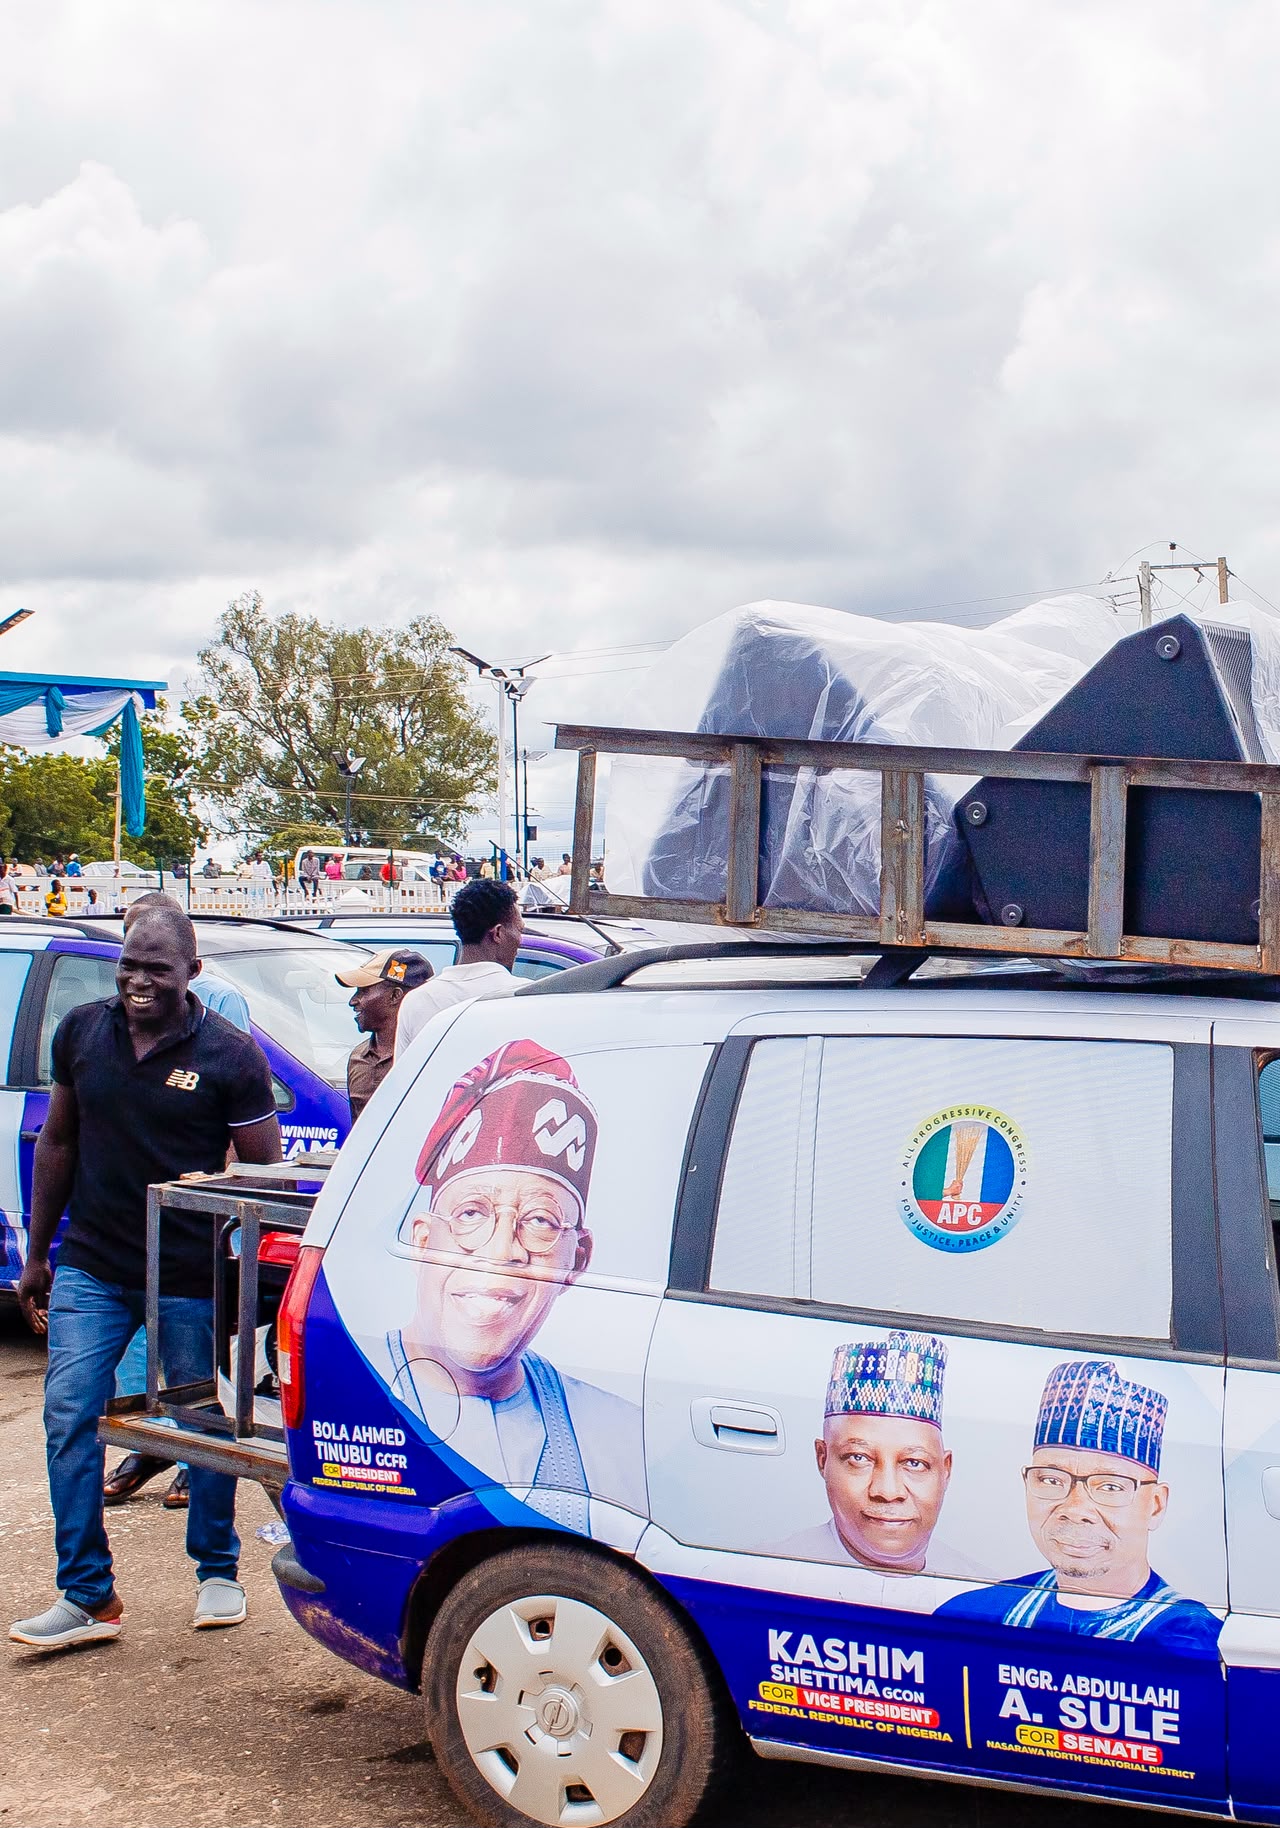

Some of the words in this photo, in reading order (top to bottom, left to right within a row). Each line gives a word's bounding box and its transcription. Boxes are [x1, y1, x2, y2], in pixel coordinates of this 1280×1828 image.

[281, 1125, 338, 1140] WINNING
[902, 1148, 915, 1168] ALL
[913, 1108, 992, 1144] PROGRESSIVE
[993, 1116, 1027, 1173] CONGRESS
[901, 1198, 914, 1219] FOR
[958, 1231, 992, 1247] PEACE
[1001, 1193, 1024, 1226] UNITY
[937, 1203, 982, 1225] APC
[312, 1420, 350, 1441] BOLA
[352, 1425, 406, 1446] AHMED
[314, 1440, 372, 1465] TINUBU
[375, 1452, 407, 1469] GCFR
[324, 1465, 339, 1475] FOR
[341, 1465, 400, 1482] PRESIDENT
[375, 1484, 387, 1492] OF
[768, 1628, 924, 1684] KASHIM
[770, 1664, 880, 1698] SHETTIMA
[882, 1686, 925, 1704] GCON
[998, 1664, 1058, 1691] ENGR.
[1061, 1674, 1180, 1709] ABDULLAHI
[748, 1700, 807, 1719] FEDERAL
[809, 1711, 874, 1730] REPUBLIC
[875, 1722, 895, 1733] OF
[896, 1725, 953, 1742] NIGERIA
[762, 1685, 794, 1700] FOR
[803, 1690, 841, 1710] VICE
[844, 1697, 932, 1724] PRESIDENT
[999, 1688, 1043, 1723] A.
[1059, 1696, 1180, 1744] SULE
[986, 1740, 1046, 1757] NASARAWA
[1046, 1749, 1082, 1763] NORTH
[1083, 1755, 1148, 1773] SENATORIAL
[1149, 1765, 1196, 1780] DISTRICT
[1019, 1729, 1055, 1745] FOR
[1063, 1734, 1158, 1762] SENATE
